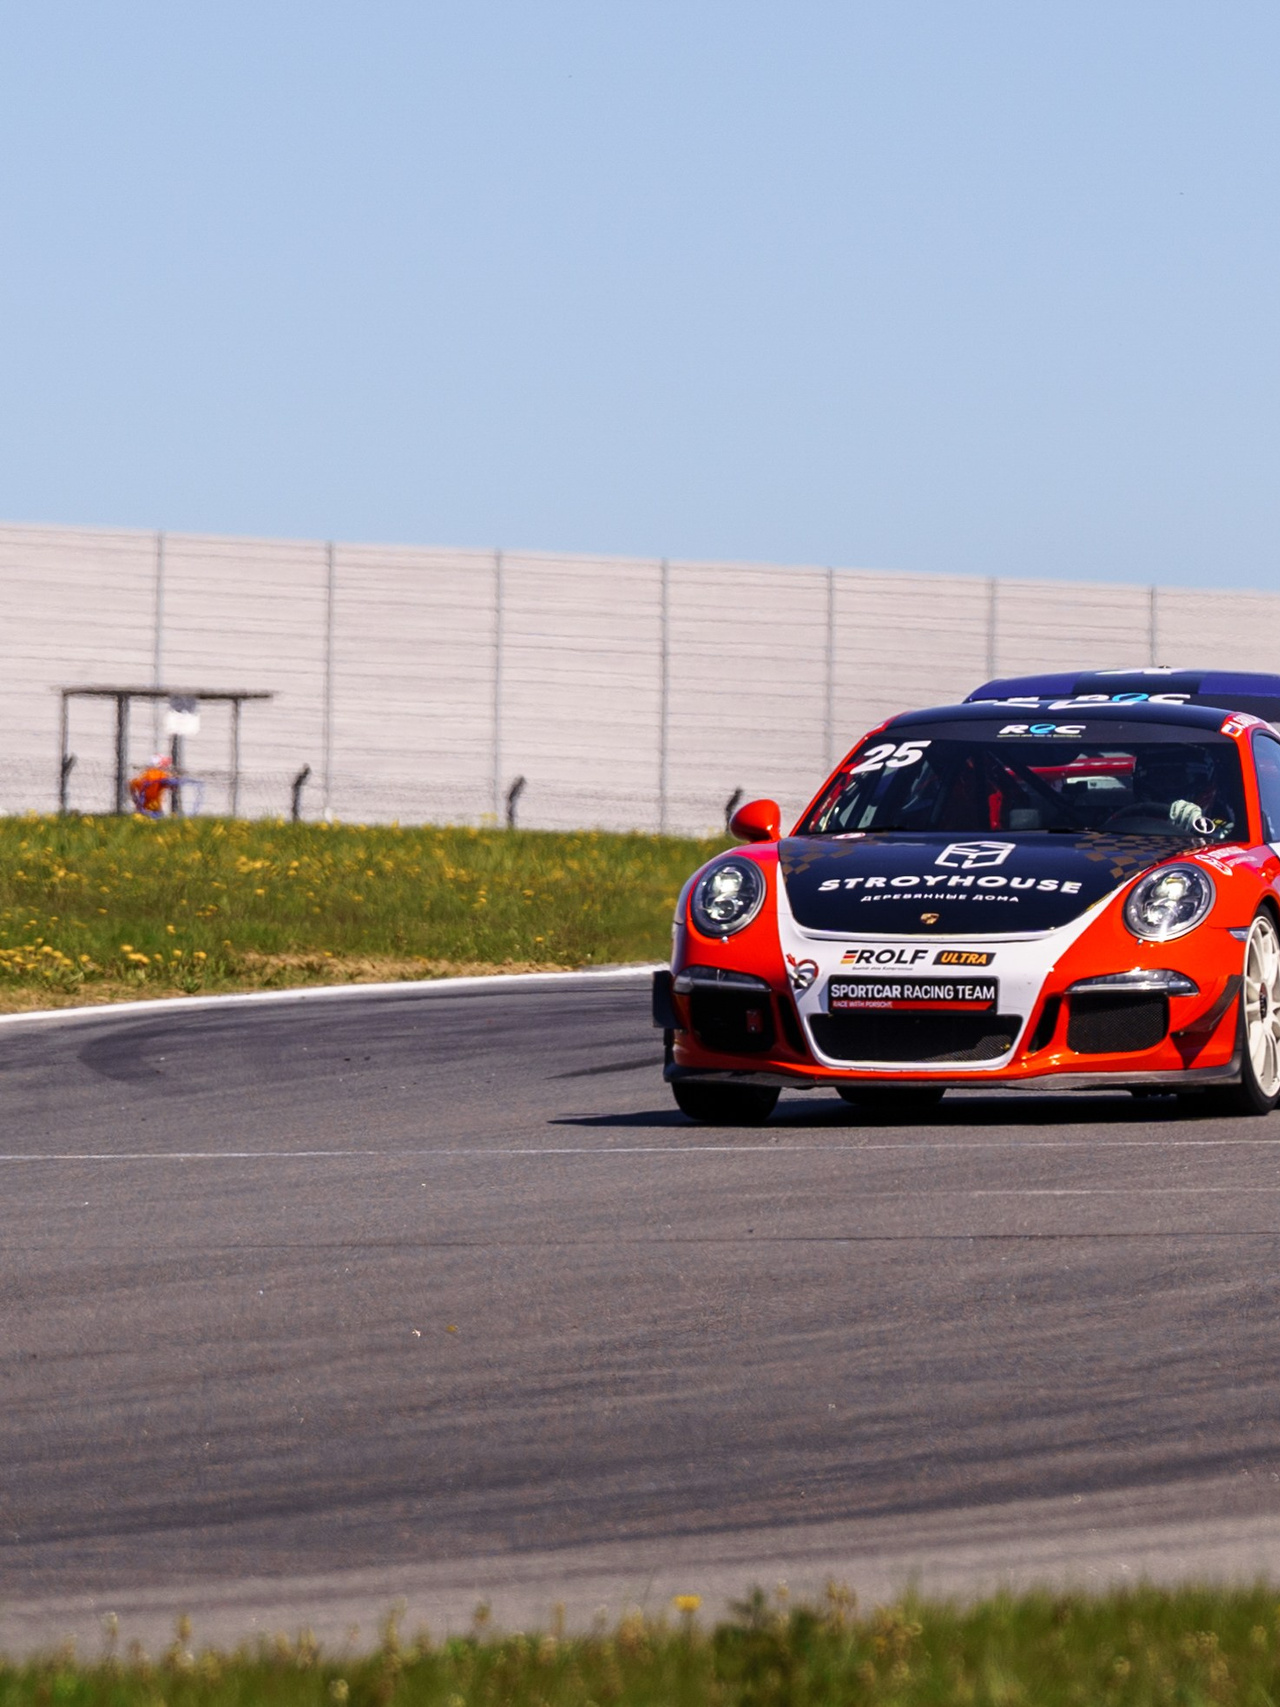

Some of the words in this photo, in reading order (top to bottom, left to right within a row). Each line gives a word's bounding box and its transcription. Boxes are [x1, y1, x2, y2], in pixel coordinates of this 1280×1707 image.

[849, 740, 932, 775] 25
[817, 875, 1083, 894] STROYHOUSE
[860, 893, 968, 902] ДЕРЕВЯННЫЕ
[972, 894, 1019, 902] ДОМА
[855, 949, 929, 964] ROLF
[940, 952, 987, 964] ULTRA
[831, 984, 901, 998] SPORTCAR
[904, 985, 954, 999] RACING
[956, 985, 995, 999] TEAM
